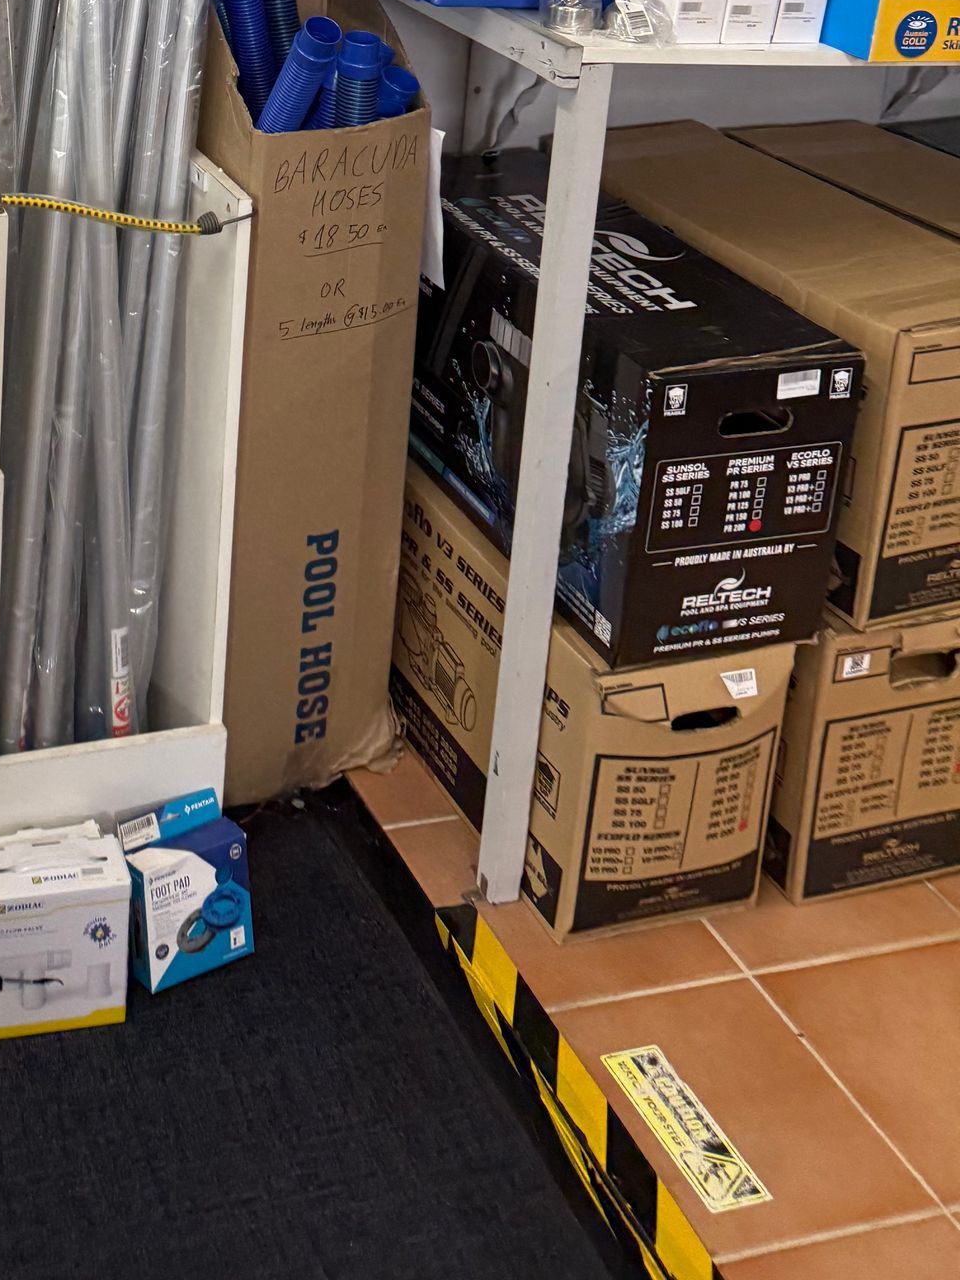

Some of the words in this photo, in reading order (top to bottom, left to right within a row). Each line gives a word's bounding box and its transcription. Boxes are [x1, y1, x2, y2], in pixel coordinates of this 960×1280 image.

[902, 37, 927, 46] GOLD
[273, 134, 418, 193] BARACUDA
[311, 182, 385, 217] HOSES
[320, 278, 346, 298] OR
[279, 319, 295, 337] 5
[300, 312, 336, 335] lengths
[728, 455, 775, 467] PREMIUM
[787, 460, 800, 469] VS
[800, 456, 833, 467] SERIES
[791, 449, 831, 461] ECOFLO
[662, 474, 675, 483] SS
[675, 470, 710, 481] SERIES
[666, 462, 708, 474] SUNSOL
[726, 467, 740, 476] PR
[741, 463, 775, 475] SERIES
[674, 553, 709, 567] PROUDLY
[709, 550, 731, 562] MADE
[732, 549, 742, 559] IN
[743, 545, 782, 558] AUSTRALIA
[784, 543, 795, 554] BY
[302, 528, 340, 634] POOL
[435, 568, 455, 596] SS
[436, 532, 454, 561] V3
[455, 555, 506, 615] SERIES
[681, 586, 772, 610] RELTECH
[730, 598, 769, 611] EQUIPMENT
[748, 613, 786, 625] SERIES
[653, 640, 692, 654] PREMIUM
[723, 632, 751, 644] SERIES
[294, 641, 333, 745] HOSE
[191, 797, 215, 811] PENTAIR
[150, 881, 171, 902] FOOT
[173, 875, 191, 892] PAD
[643, 1096, 668, 1126] YOUR
